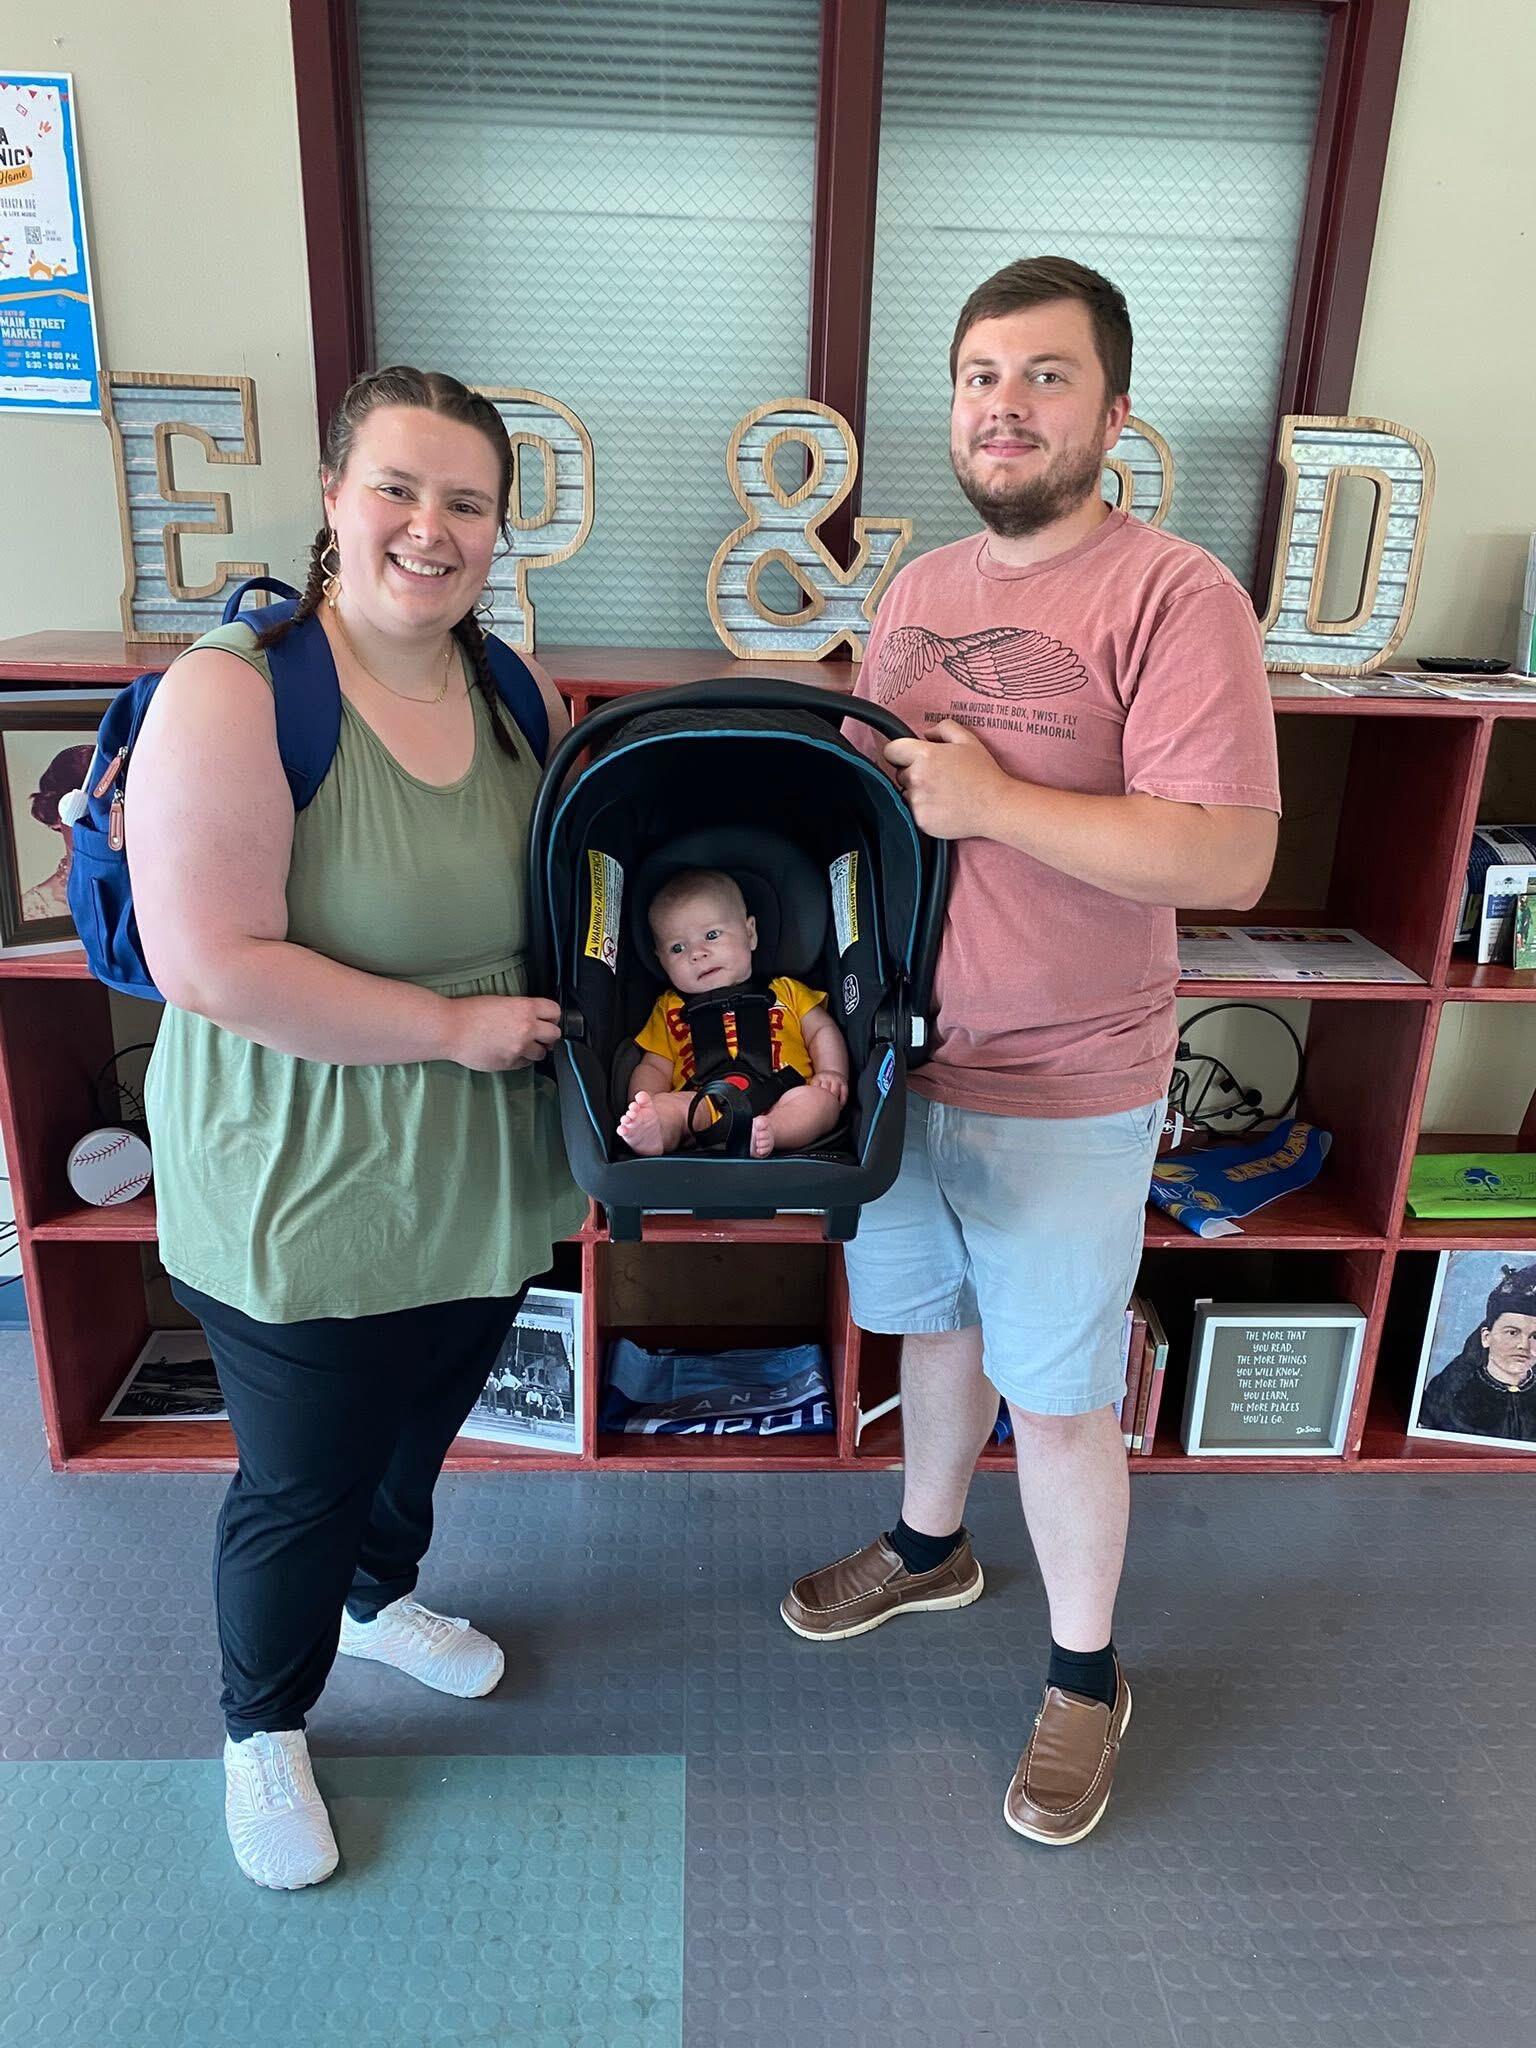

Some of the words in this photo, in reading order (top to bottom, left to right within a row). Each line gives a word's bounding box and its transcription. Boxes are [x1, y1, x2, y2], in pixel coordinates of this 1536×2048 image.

[0, 316, 26, 328] MAIN
[29, 318, 66, 329] STREET
[1, 328, 43, 339] MARKET
[950, 700, 968, 711] THINK
[968, 702, 995, 714] OUTSIDE
[996, 704, 1009, 716] THE
[1063, 714, 1078, 726] FLY
[987, 717, 1024, 733] NATIONAL
[1026, 722, 1077, 740] MEMORIAL
[591, 906, 603, 945] WARNING
[1246, 1331, 1259, 1340] THE
[1262, 1331, 1283, 1340] MORE
[1287, 1331, 1307, 1340] THAT
[1253, 1344, 1268, 1353] YOU
[1271, 1343, 1294, 1353] READ,
[1237, 1356, 1251, 1365] THE
[1253, 1356, 1275, 1364] MORE
[1278, 1355, 1307, 1365] THINGS
[1237, 1368, 1252, 1377] YOU
[1255, 1368, 1273, 1376] WILL
[1239, 1379, 1252, 1388] THE
[1255, 1379, 1276, 1388] MORE
[1280, 1379, 1299, 1388] THAT
[1244, 1391, 1259, 1400] YOU
[1262, 1391, 1289, 1400] LEARN,
[1230, 1403, 1244, 1412] THE
[1246, 1403, 1268, 1412] MORE
[1271, 1402, 1300, 1412] PLACES
[1243, 1414, 1268, 1424] YOU'LL
